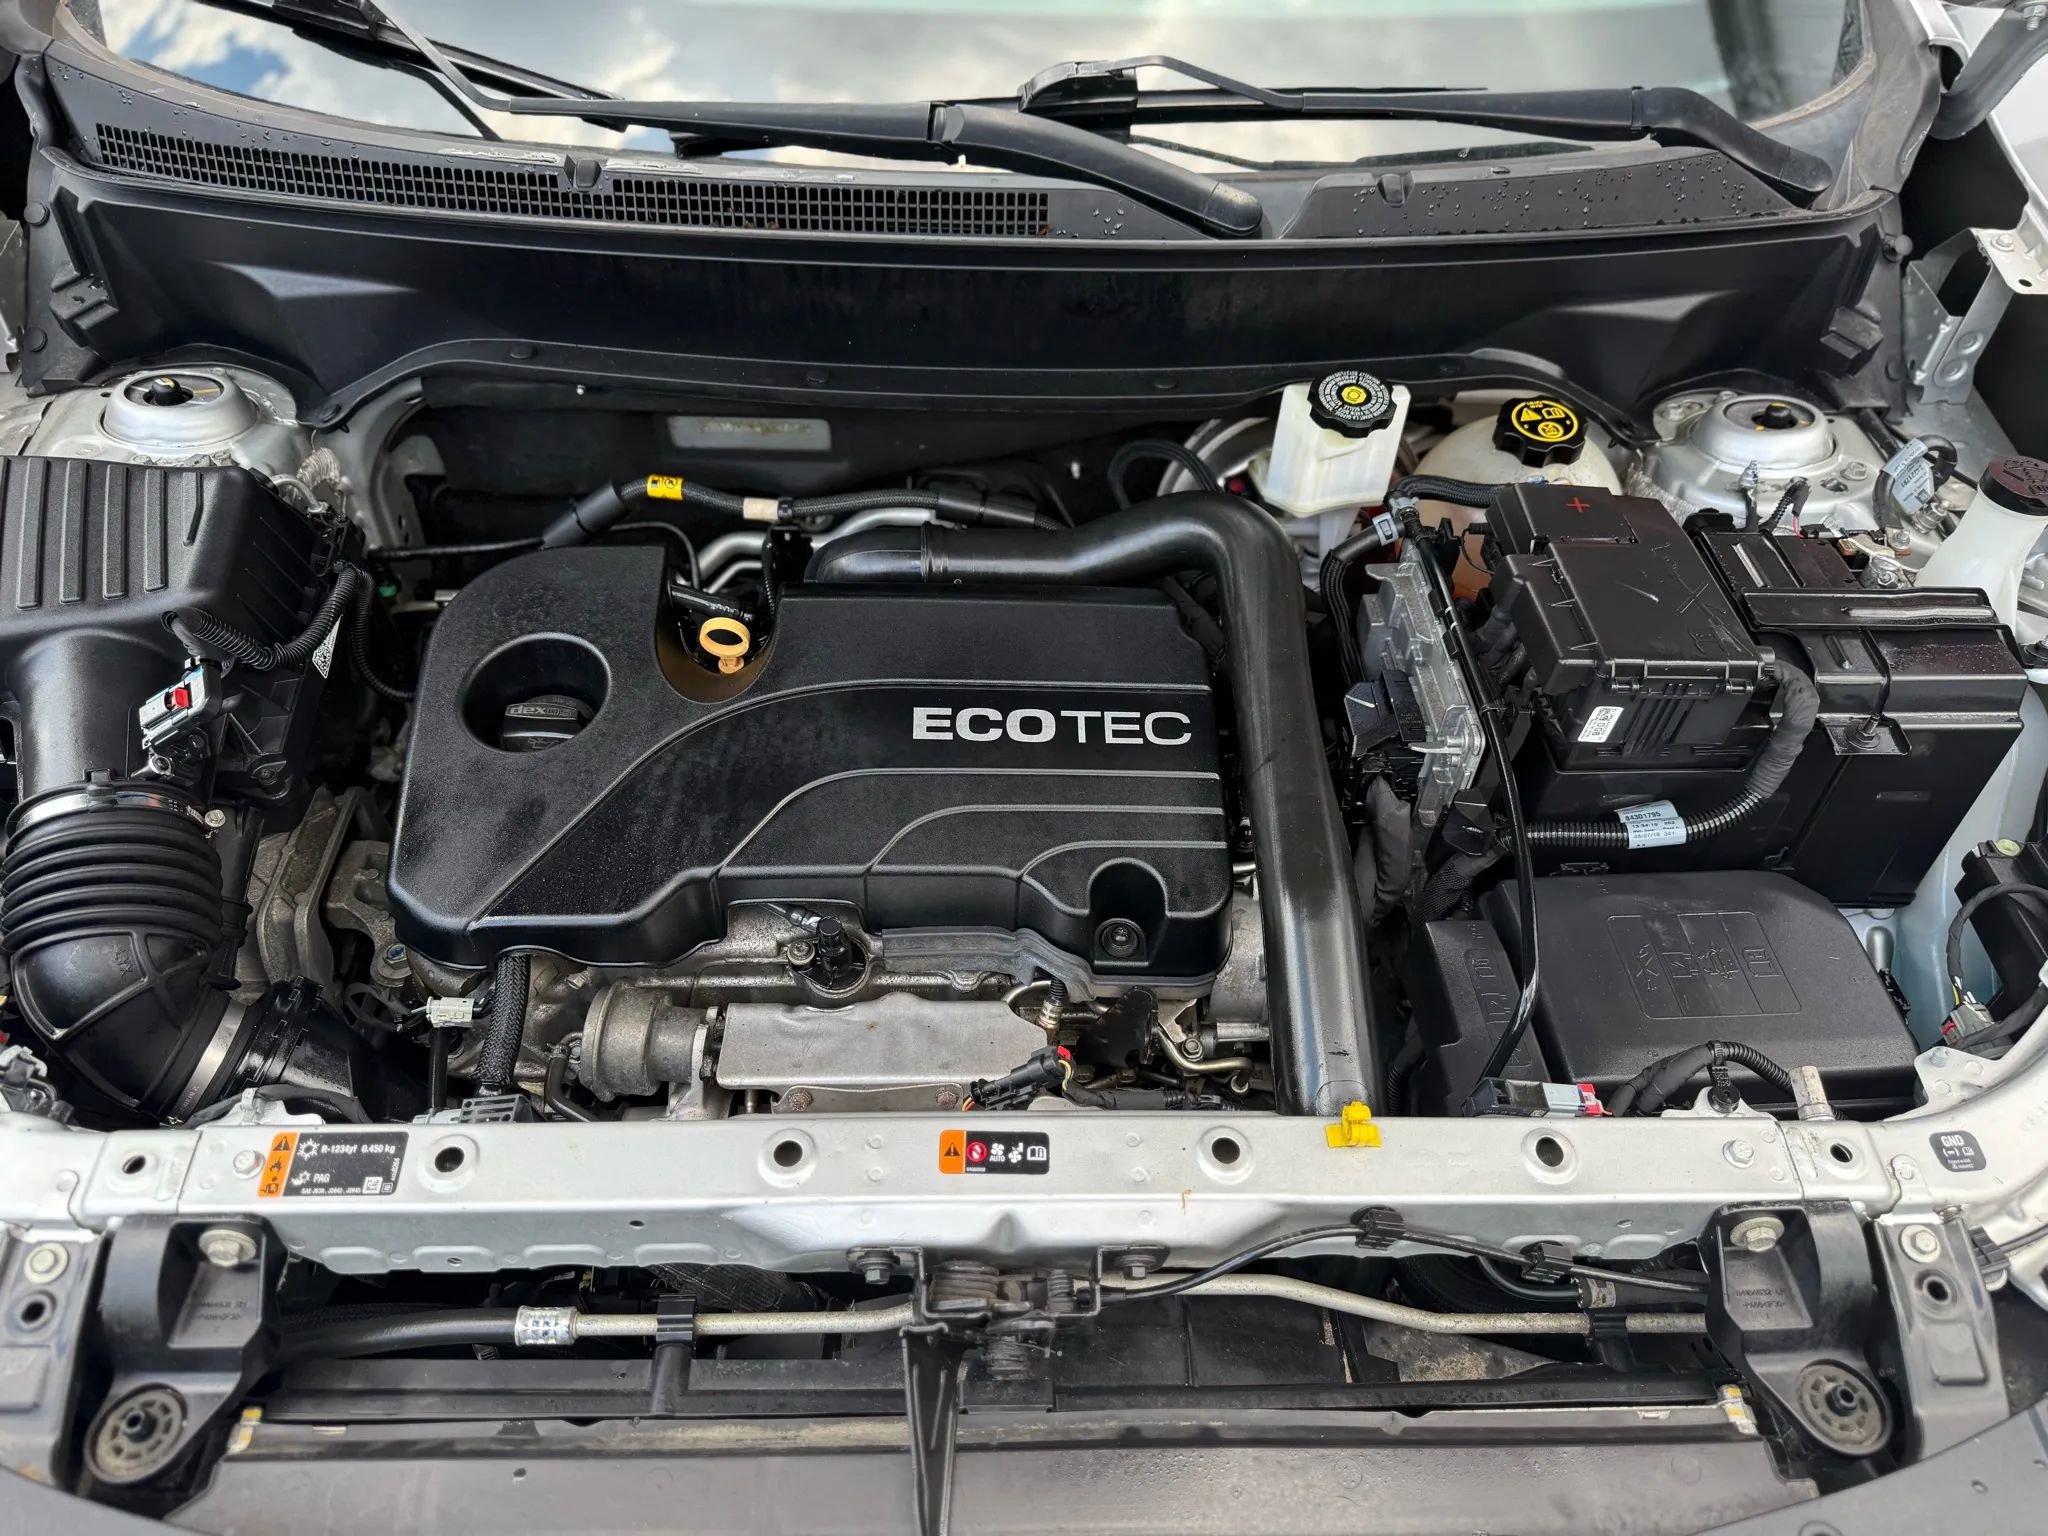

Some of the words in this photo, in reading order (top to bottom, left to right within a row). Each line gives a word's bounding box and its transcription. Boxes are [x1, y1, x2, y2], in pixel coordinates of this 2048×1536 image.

[912, 706, 1192, 746] ECOTEC
[1940, 1134, 1965, 1147] GND
[321, 1144, 357, 1155] R-1234yf
[361, 1144, 384, 1153] 0.450
[384, 1144, 396, 1154] kg
[313, 1173, 331, 1183] PAG
